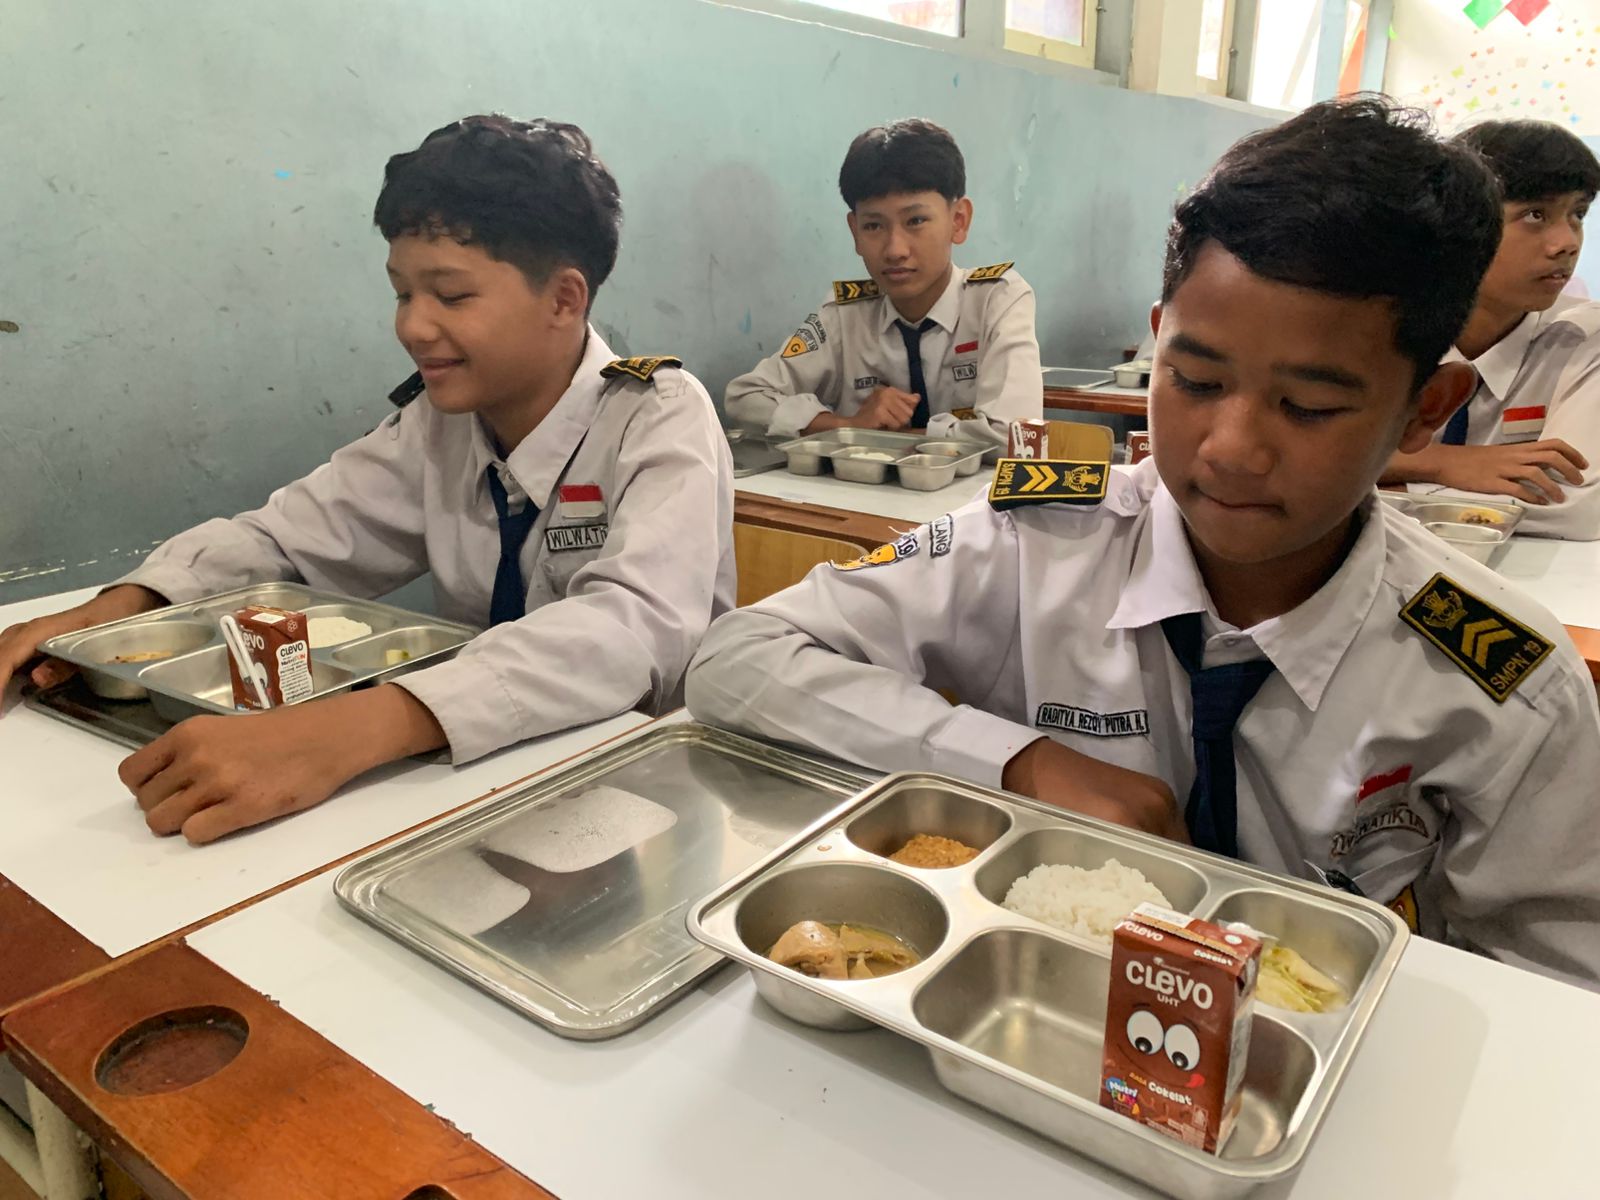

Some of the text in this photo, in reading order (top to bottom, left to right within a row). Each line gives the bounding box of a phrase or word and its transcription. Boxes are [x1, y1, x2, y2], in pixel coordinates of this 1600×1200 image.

[790, 343, 801, 353] G
[998, 463, 1016, 485] SMPN
[897, 537, 914, 556] 19
[933, 519, 949, 552] LANG
[1490, 640, 1542, 690] SMPN 19
[1040, 706, 1075, 728] RADITYA
[1104, 715, 1133, 733] PUTRA
[1156, 993, 1181, 1008] UHT
[1109, 1080, 1138, 1098] Nutri
[1147, 1081, 1193, 1106] Cokelat
